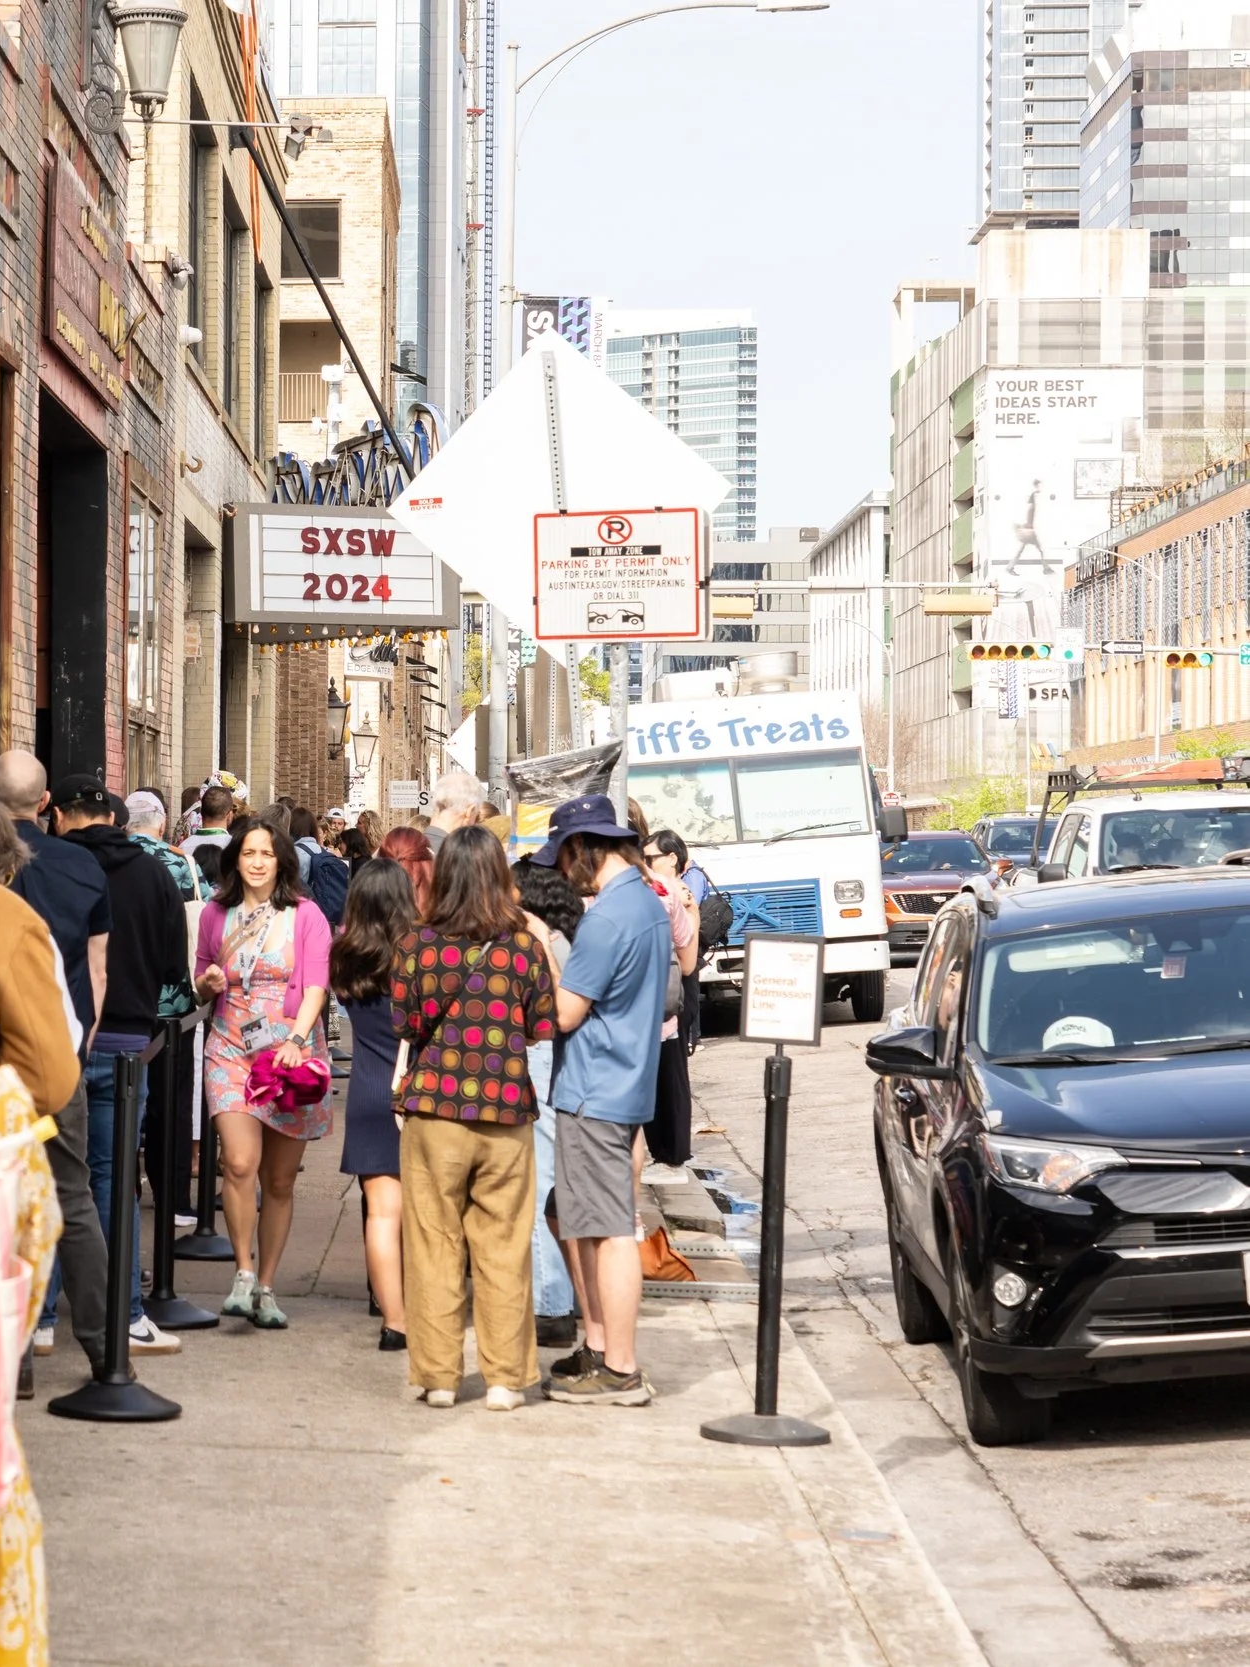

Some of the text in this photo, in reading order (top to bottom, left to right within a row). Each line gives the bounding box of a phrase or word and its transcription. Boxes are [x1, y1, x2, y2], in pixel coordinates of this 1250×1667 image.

[594, 312, 603, 353] MARCH
[996, 380, 1084, 392] YOUR BEST
[995, 396, 1097, 408] IDEAS START
[995, 413, 1040, 425] HERE.
[301, 526, 396, 557] SXSW
[588, 546, 643, 556] TOW AWAY ZONE
[541, 556, 691, 569] PARKING BY PERMIT ONLY
[564, 568, 668, 579] FOR PERMIT INFORMATION
[303, 573, 392, 602] 2024
[549, 579, 686, 590] AUSTINTEXAS.GOV/STREETPARKING
[593, 591, 640, 600] OR DIAL 311
[507, 649, 520, 685] 2024
[1040, 688, 1070, 700] SPA
[612, 713, 850, 755] iff's Treats
[753, 974, 797, 987] General
[753, 987, 812, 1000] Admission
[752, 1000, 776, 1011] Line
